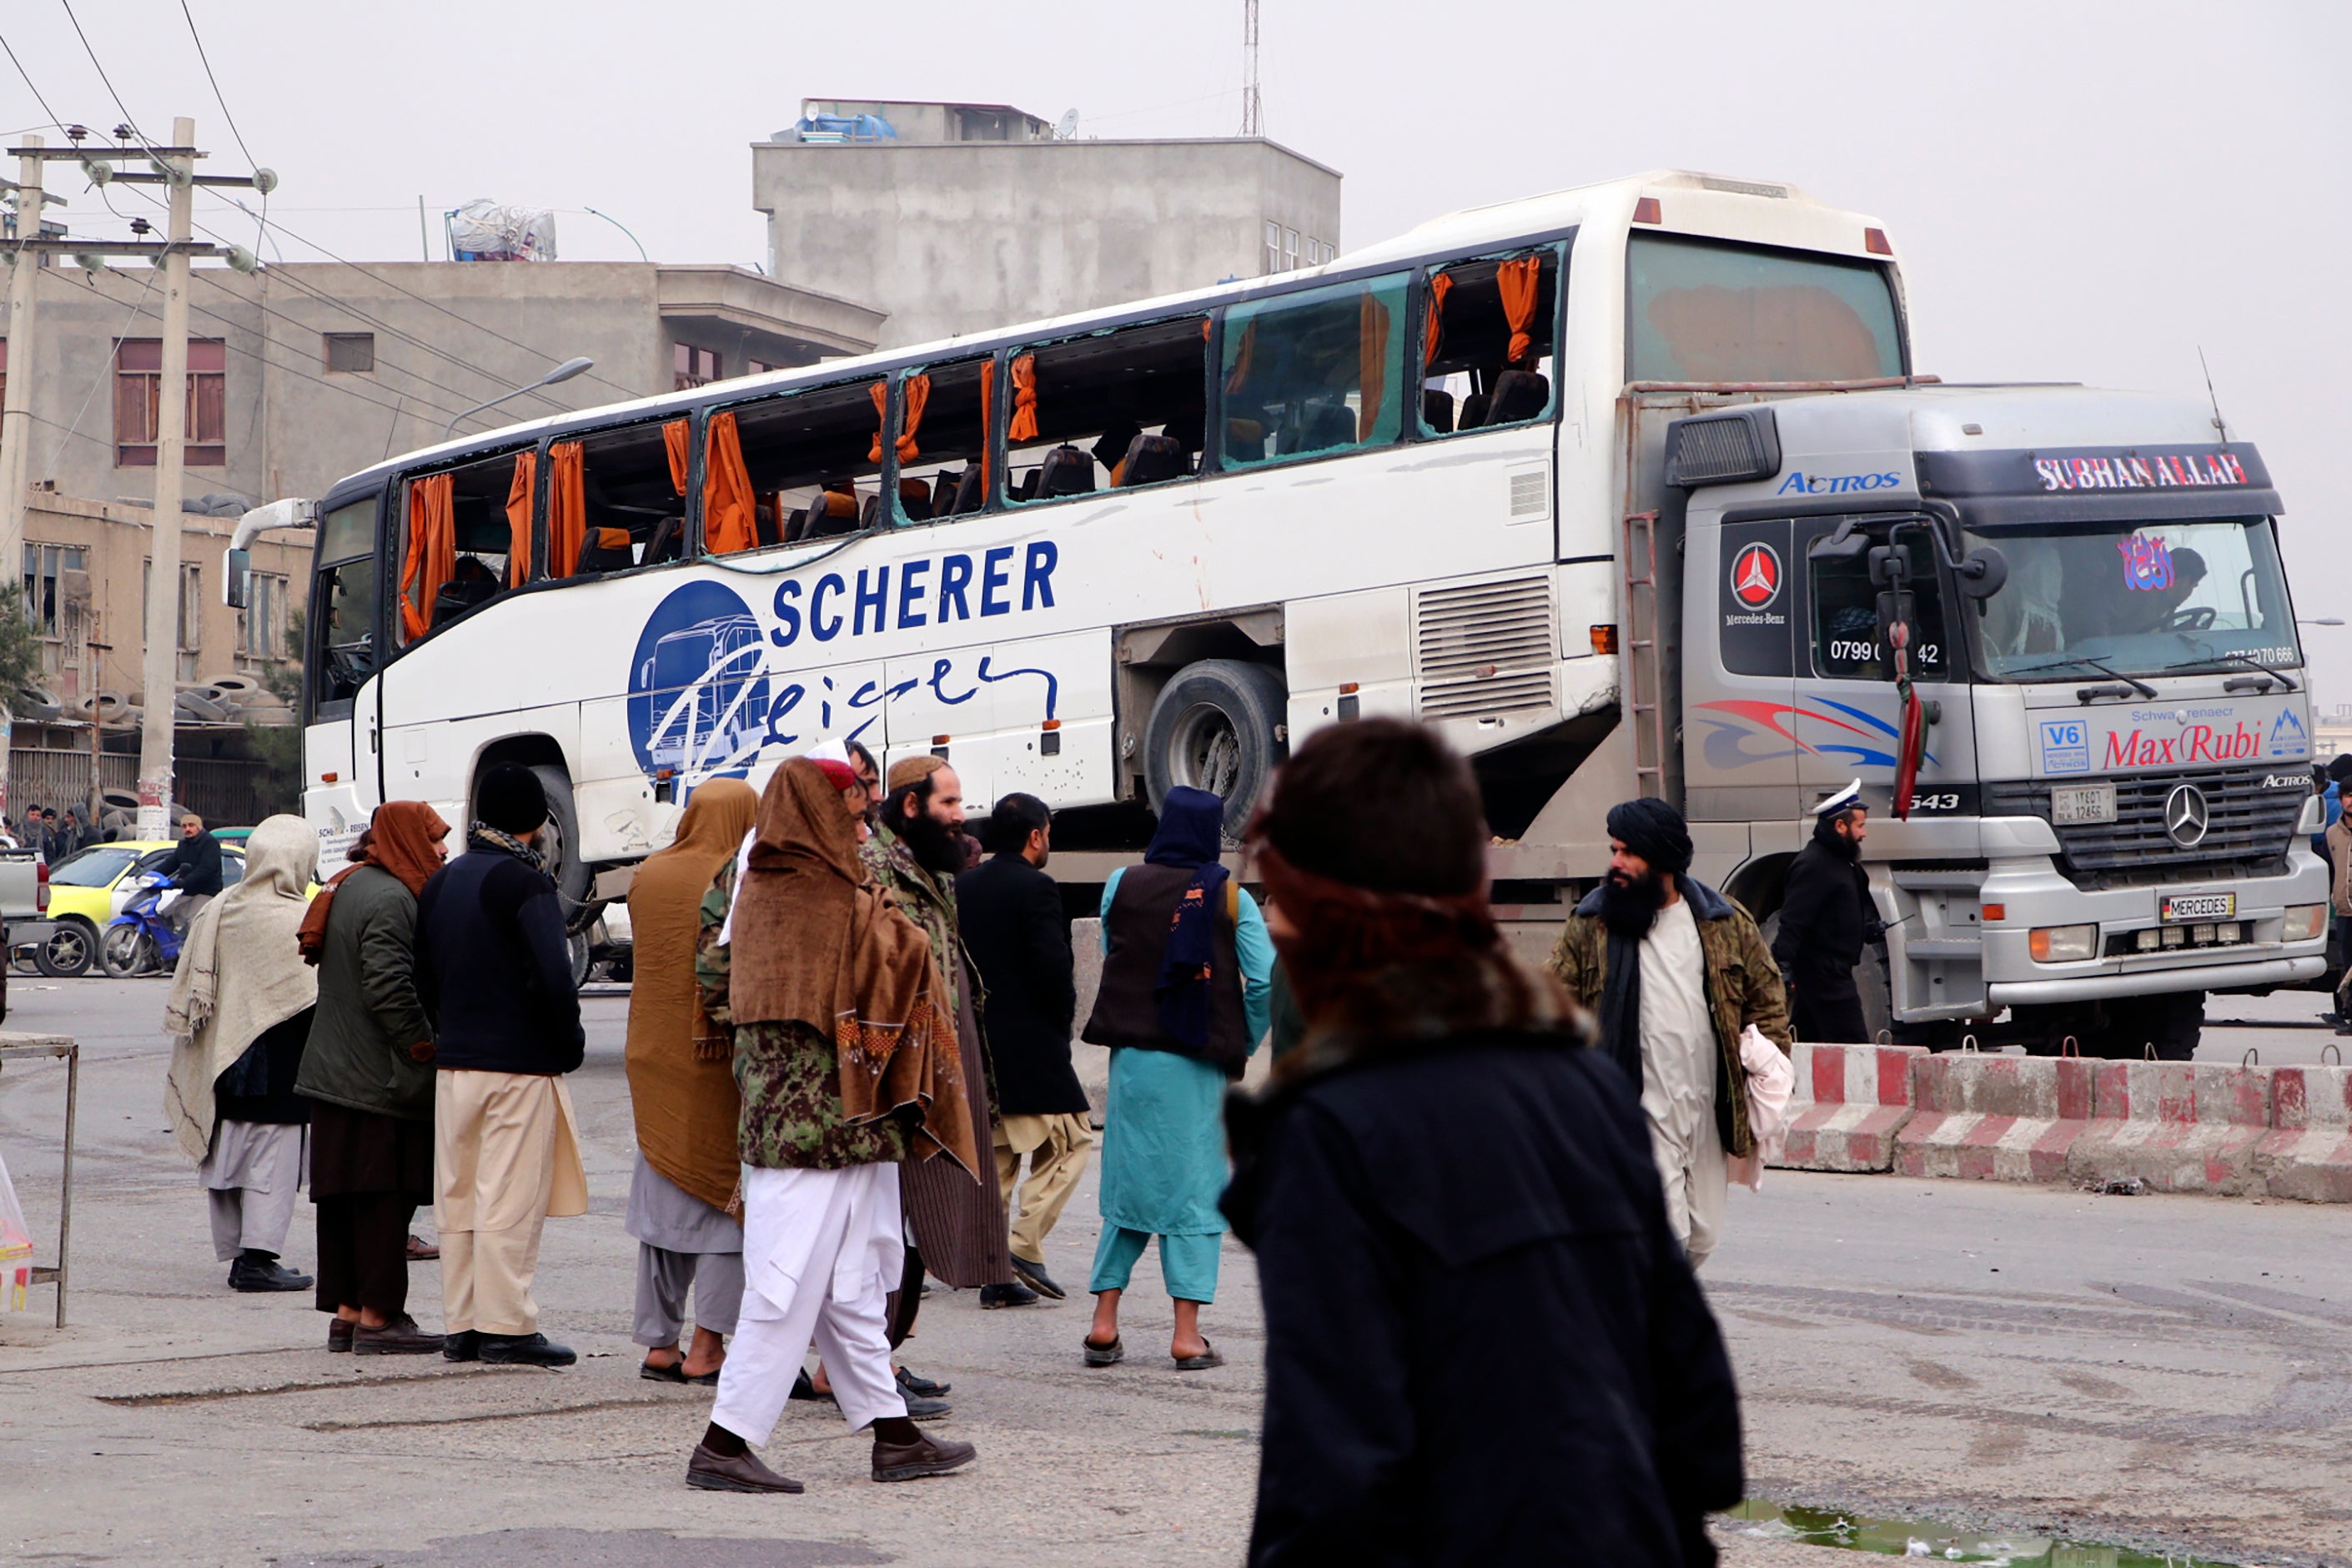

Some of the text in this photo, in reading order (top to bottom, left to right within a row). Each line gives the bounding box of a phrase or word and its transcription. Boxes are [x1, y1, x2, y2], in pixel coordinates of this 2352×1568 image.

[2033, 453, 2249, 491] SUBHAN ALLAH
[770, 540, 1058, 648] SCHERER
[1726, 612, 1786, 626] Mercedes-Benz
[1831, 640, 1872, 661] 0799
[2048, 726, 2080, 745] V6
[2103, 720, 2263, 770] Max Rubi
[2262, 774, 2312, 789] ACTROS
[1888, 793, 1960, 810] 543
[2075, 805, 2102, 820] 12456
[2171, 897, 2227, 917] MERCEDES
